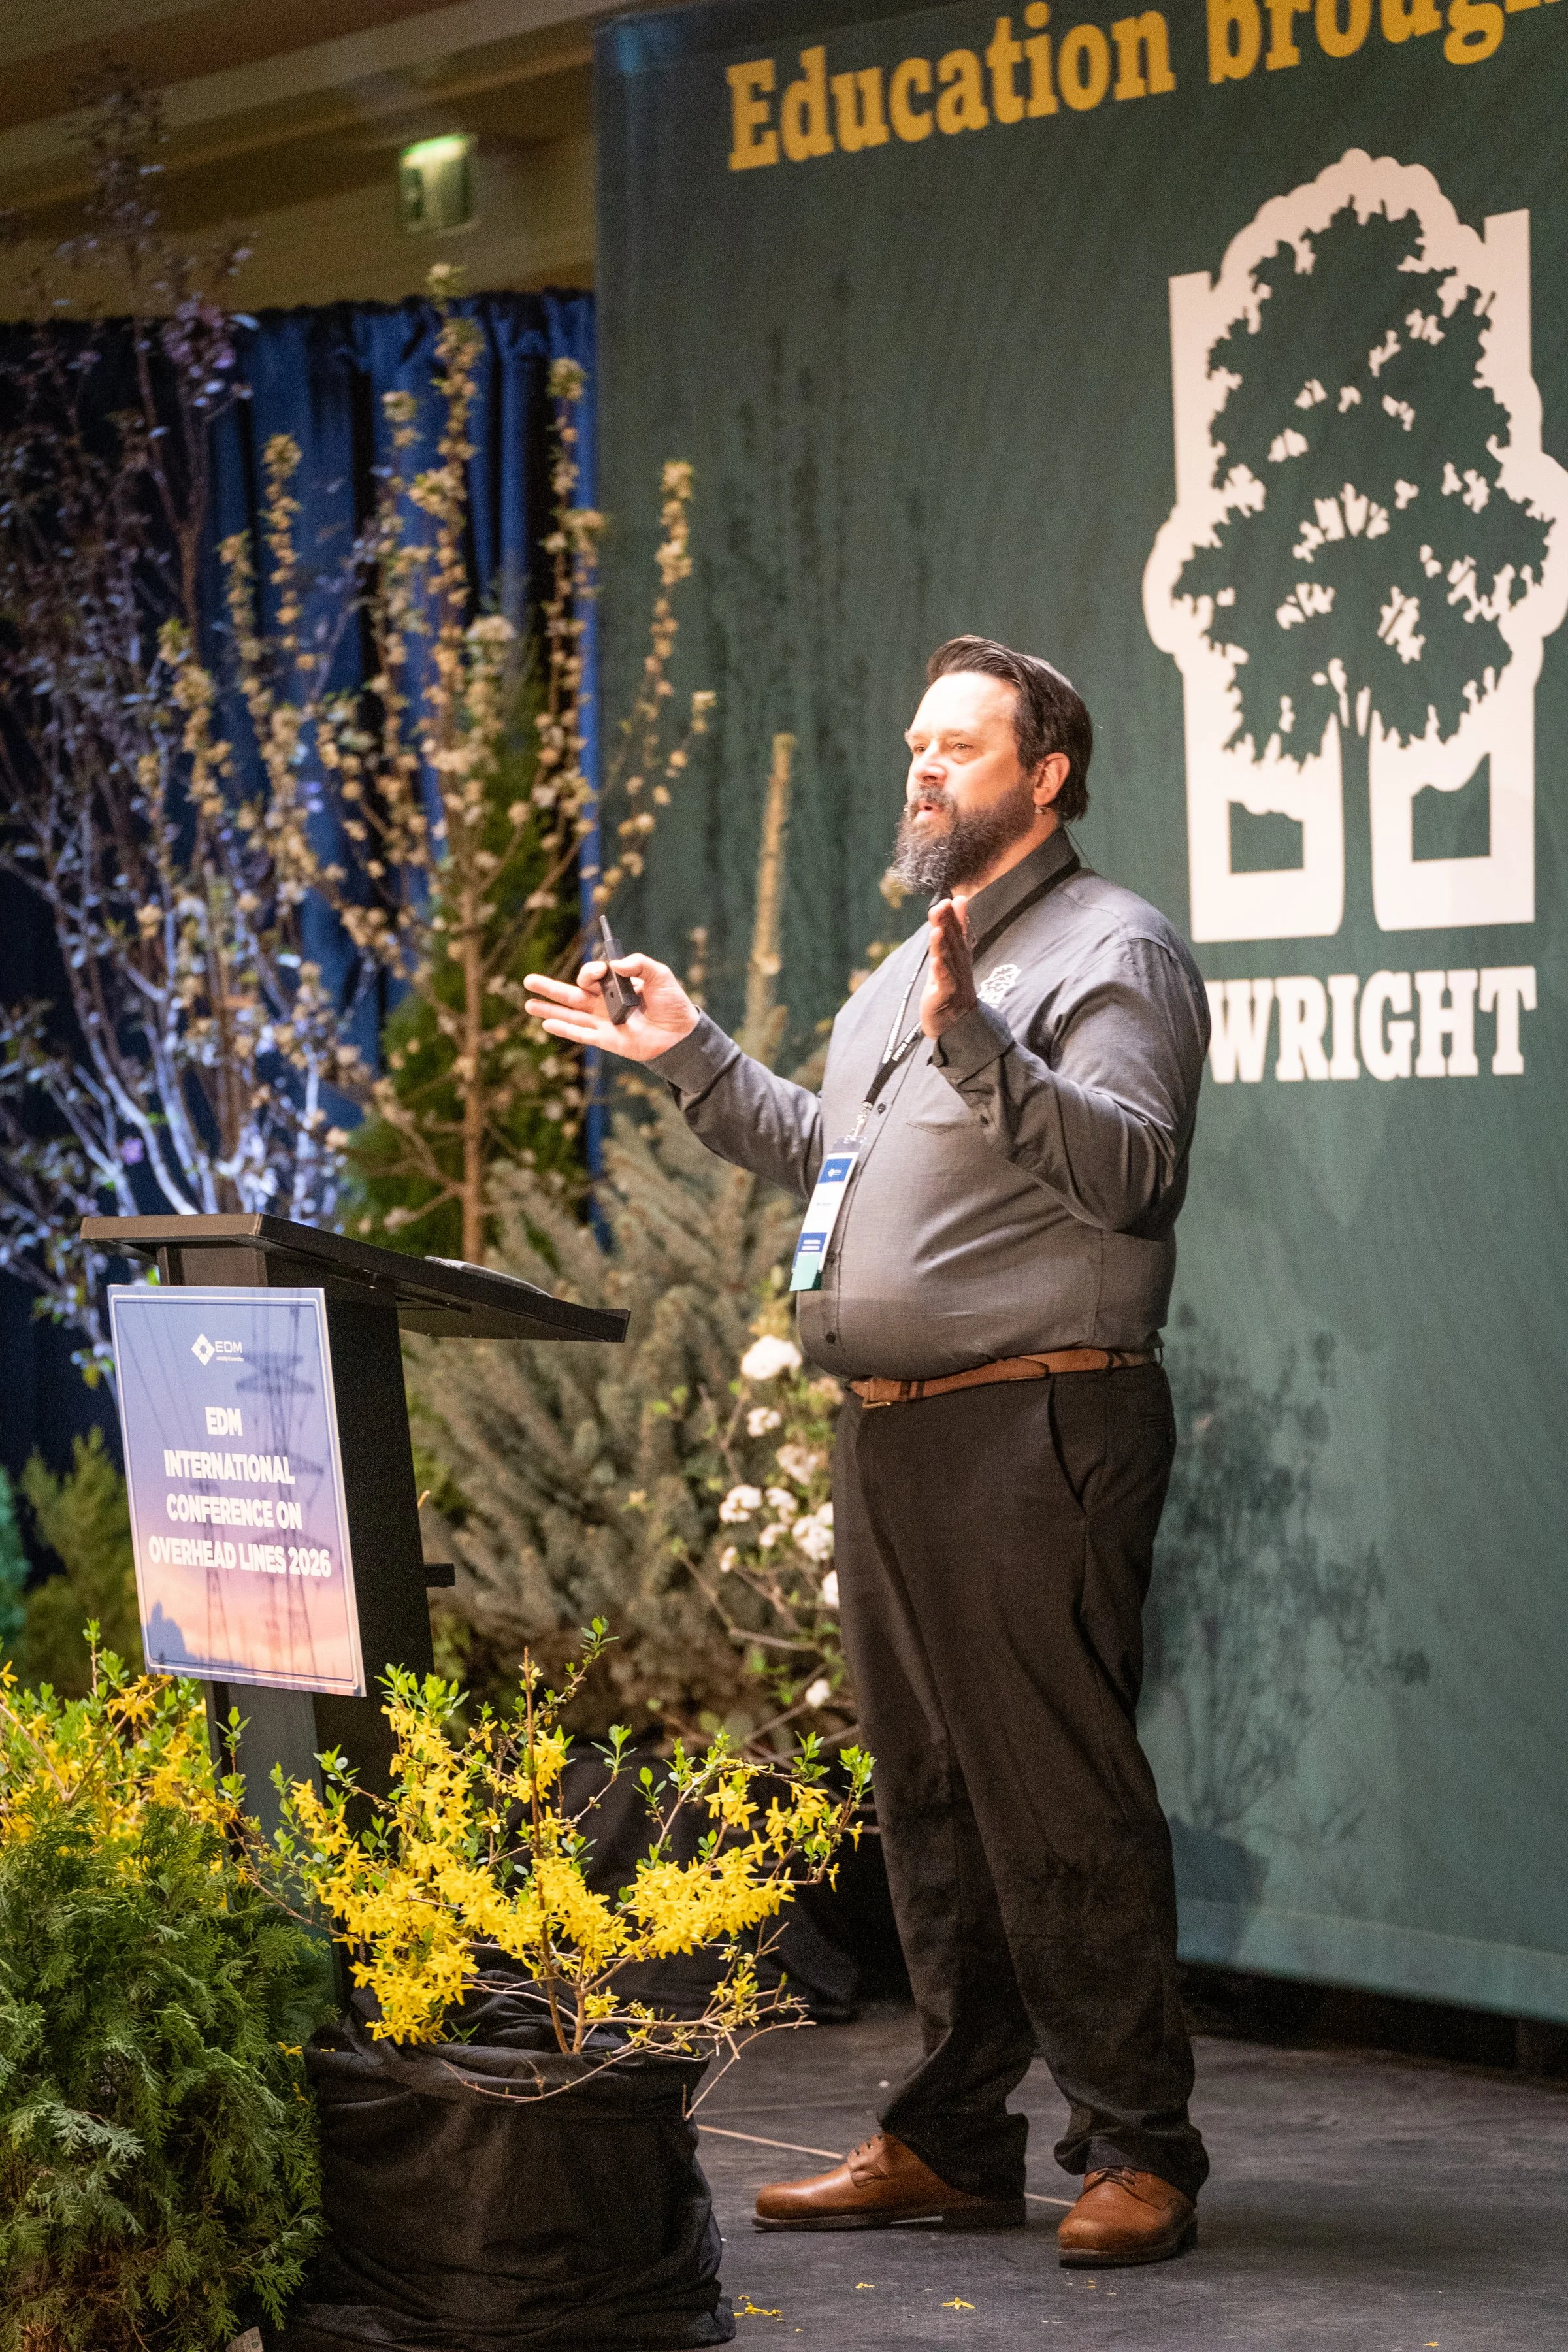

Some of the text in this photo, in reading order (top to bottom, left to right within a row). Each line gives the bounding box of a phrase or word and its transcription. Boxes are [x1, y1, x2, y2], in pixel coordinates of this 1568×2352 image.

[727, 0, 1568, 171] Education broug
[1204, 966, 1537, 1083] WRIGHT
[214, 1340, 243, 1354] EDM
[205, 1407, 243, 1436] EDM
[164, 1450, 295, 1484] INTERNATIONAL
[166, 1493, 303, 1530] CONFERENCE ON
[148, 1535, 332, 1578] OVERHEAD LINES 2026
